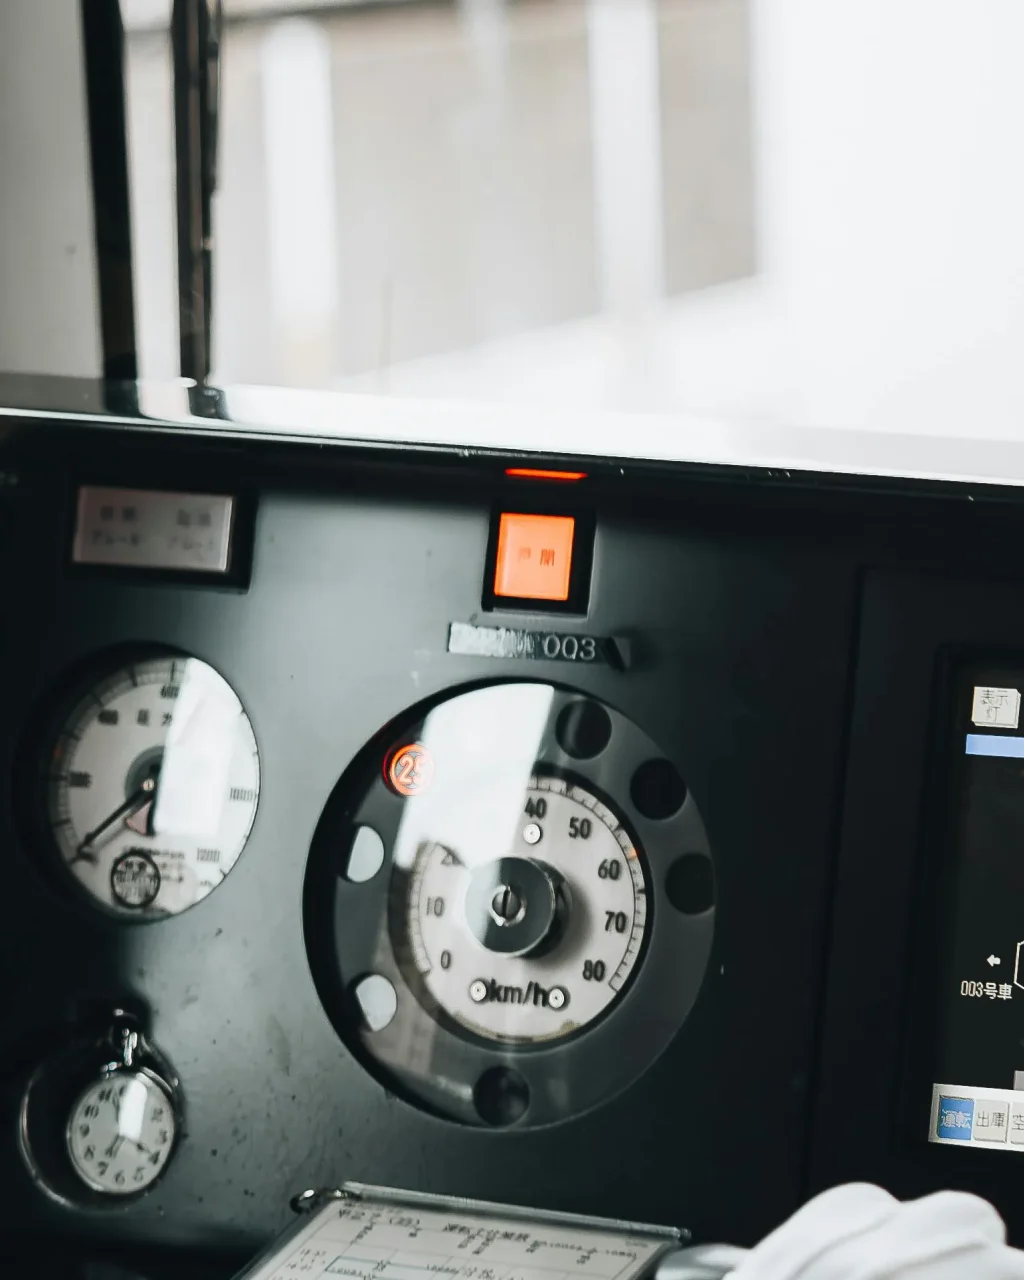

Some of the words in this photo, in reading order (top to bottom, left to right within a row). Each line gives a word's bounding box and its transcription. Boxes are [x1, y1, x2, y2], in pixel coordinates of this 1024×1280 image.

[544, 634, 596, 660] 003
[524, 797, 547, 819] 40
[568, 816, 592, 840] 50
[598, 859, 622, 881] 60
[426, 896, 445, 917] 10
[605, 910, 627, 934] 70
[440, 950, 452, 970] 0
[582, 959, 606, 982] 80
[488, 978, 551, 1008] km/h
[960, 980, 1013, 1001] 003号車
[976, 1111, 1007, 1129] 出庫
